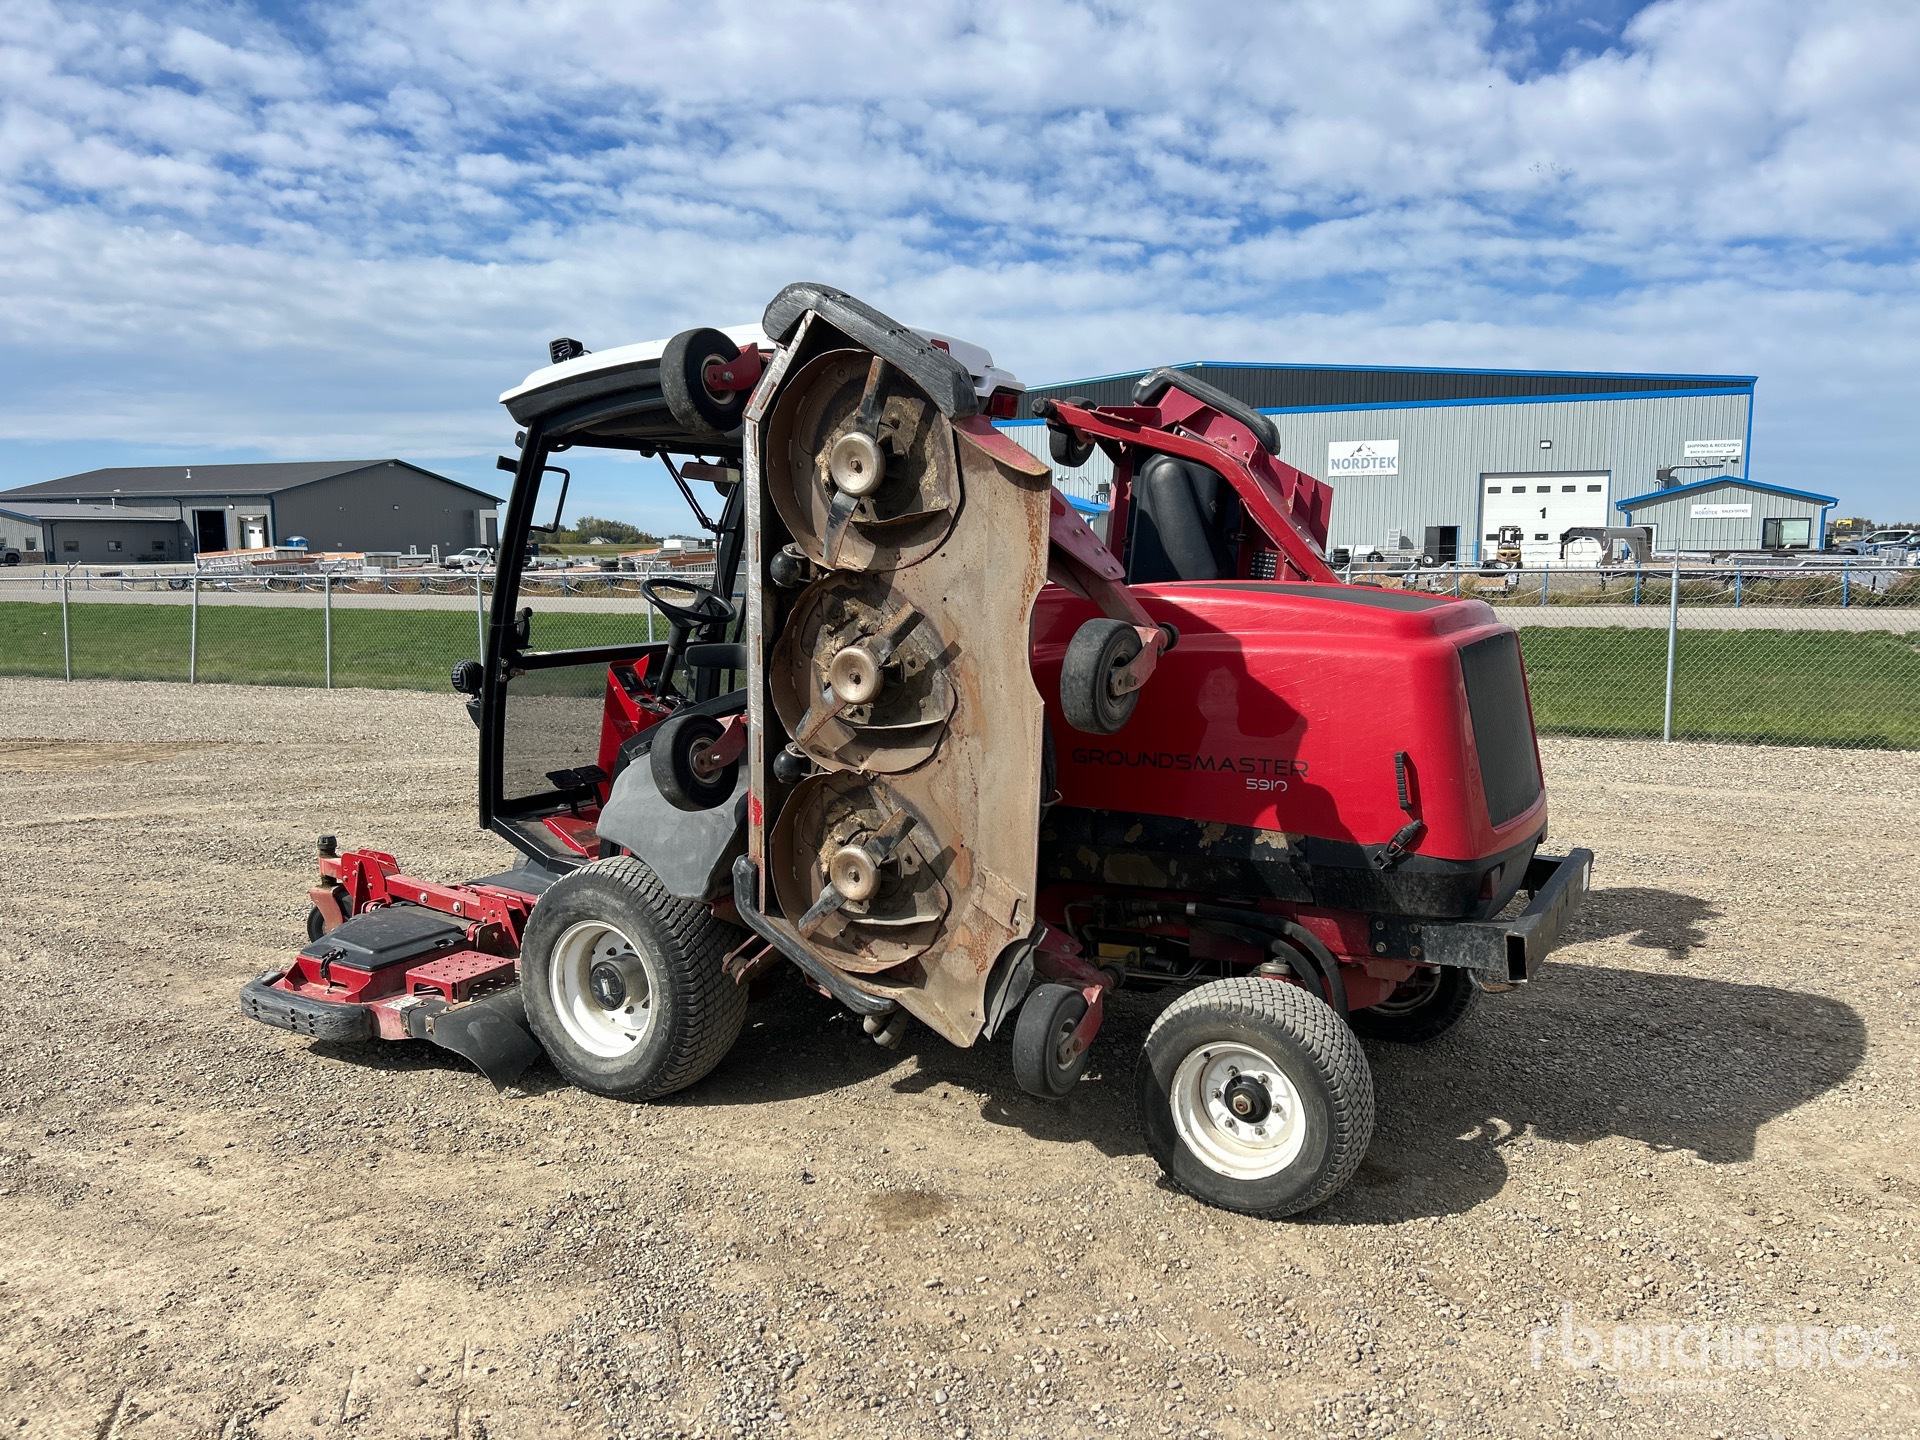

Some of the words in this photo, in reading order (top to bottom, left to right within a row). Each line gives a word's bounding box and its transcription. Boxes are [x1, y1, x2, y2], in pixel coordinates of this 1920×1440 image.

[1331, 457, 1396, 470] NORDTEK
[1539, 506, 1547, 519] 1
[1072, 748, 1309, 778] GROUNDSMASTER
[1246, 778, 1288, 792] 5910
